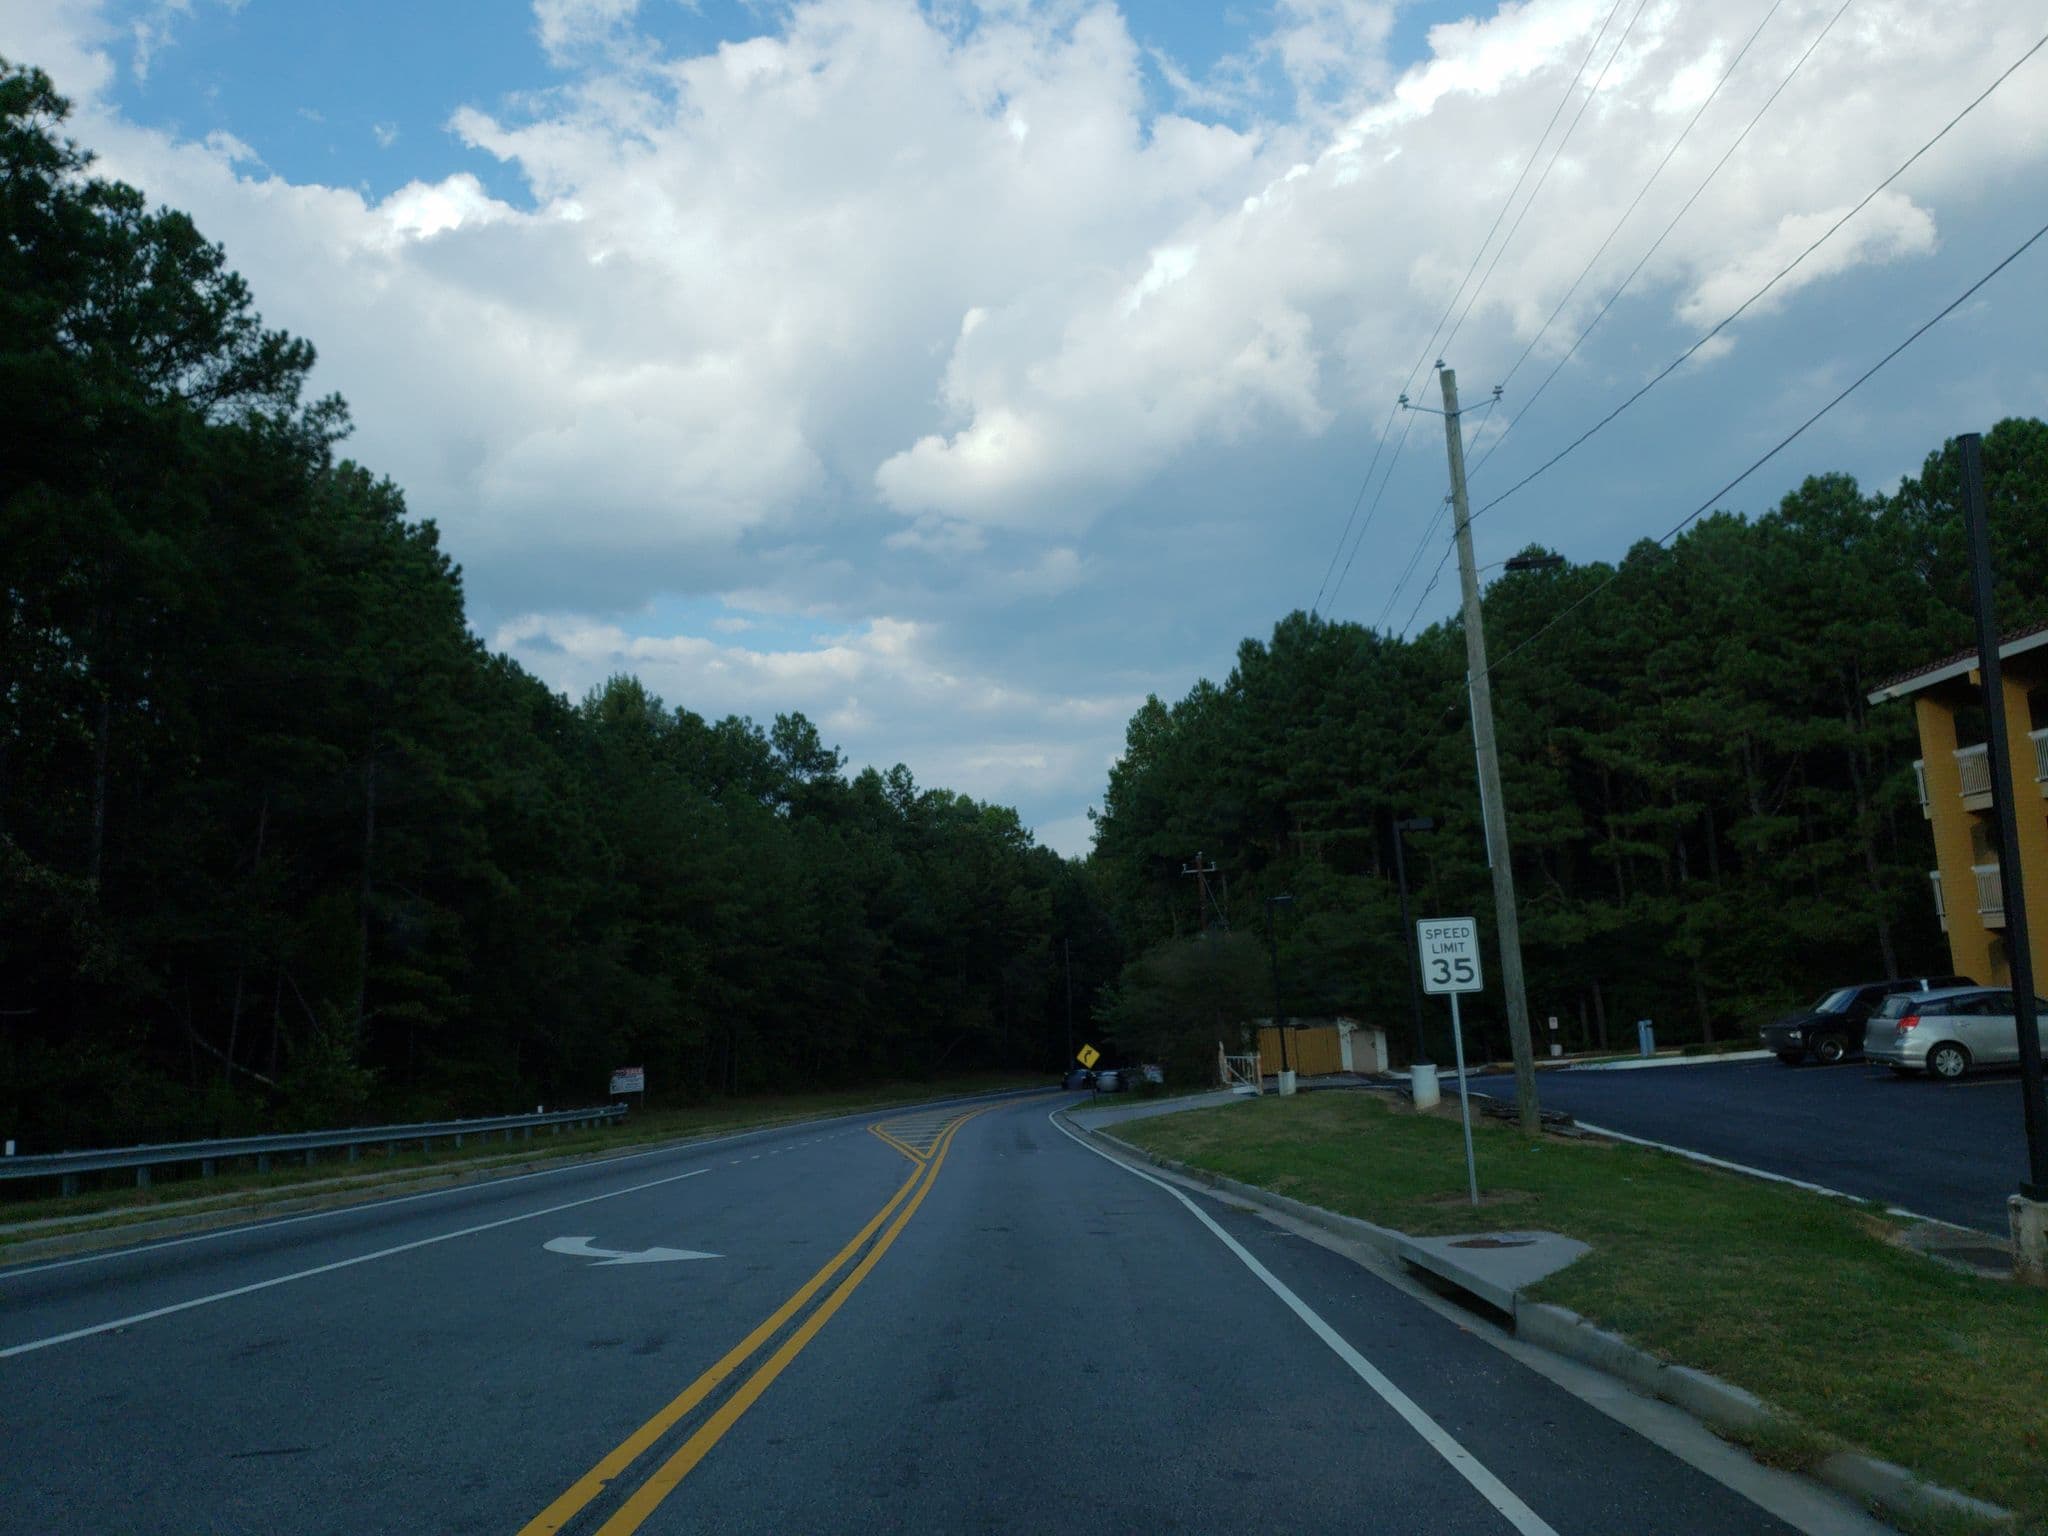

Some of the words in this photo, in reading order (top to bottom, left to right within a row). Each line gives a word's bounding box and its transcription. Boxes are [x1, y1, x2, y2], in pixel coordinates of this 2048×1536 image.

[1425, 927, 1470, 940] SPEED
[1431, 942, 1465, 954] LIMIT
[1431, 958, 1475, 984] 35
